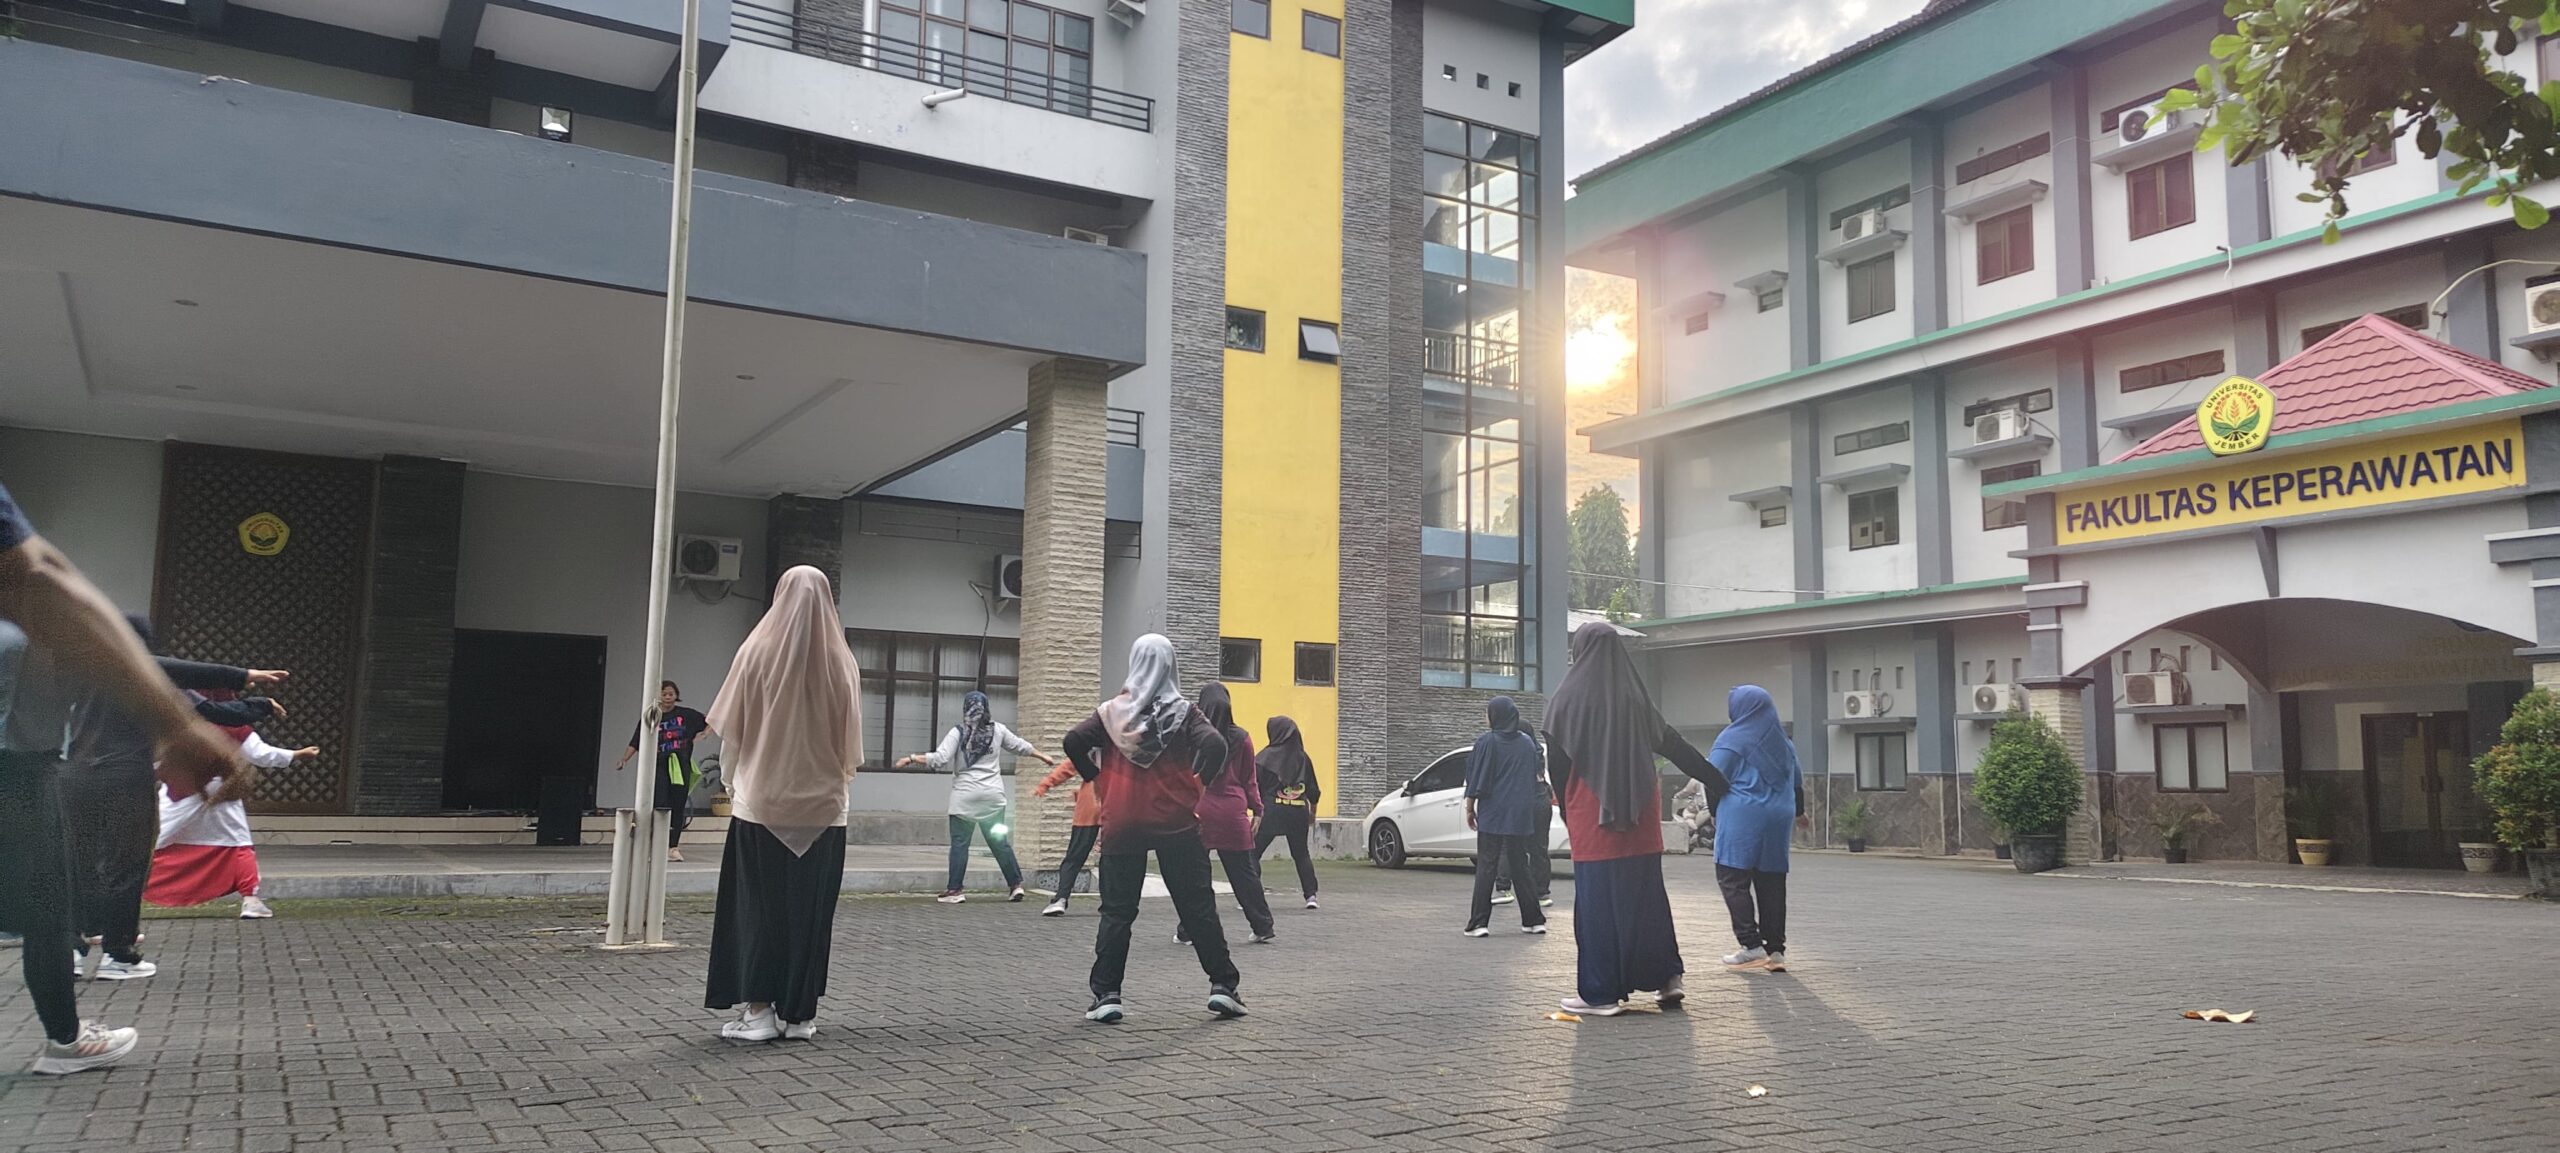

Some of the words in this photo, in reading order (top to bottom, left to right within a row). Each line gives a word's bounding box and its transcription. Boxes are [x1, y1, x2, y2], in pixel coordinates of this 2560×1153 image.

[2206, 384, 2263, 408] UNIVERSITAS
[2214, 432, 2260, 449] JEMBER
[2065, 482, 2217, 533] FAKULTAS
[2228, 438, 2514, 511] KEPERAWATAN
